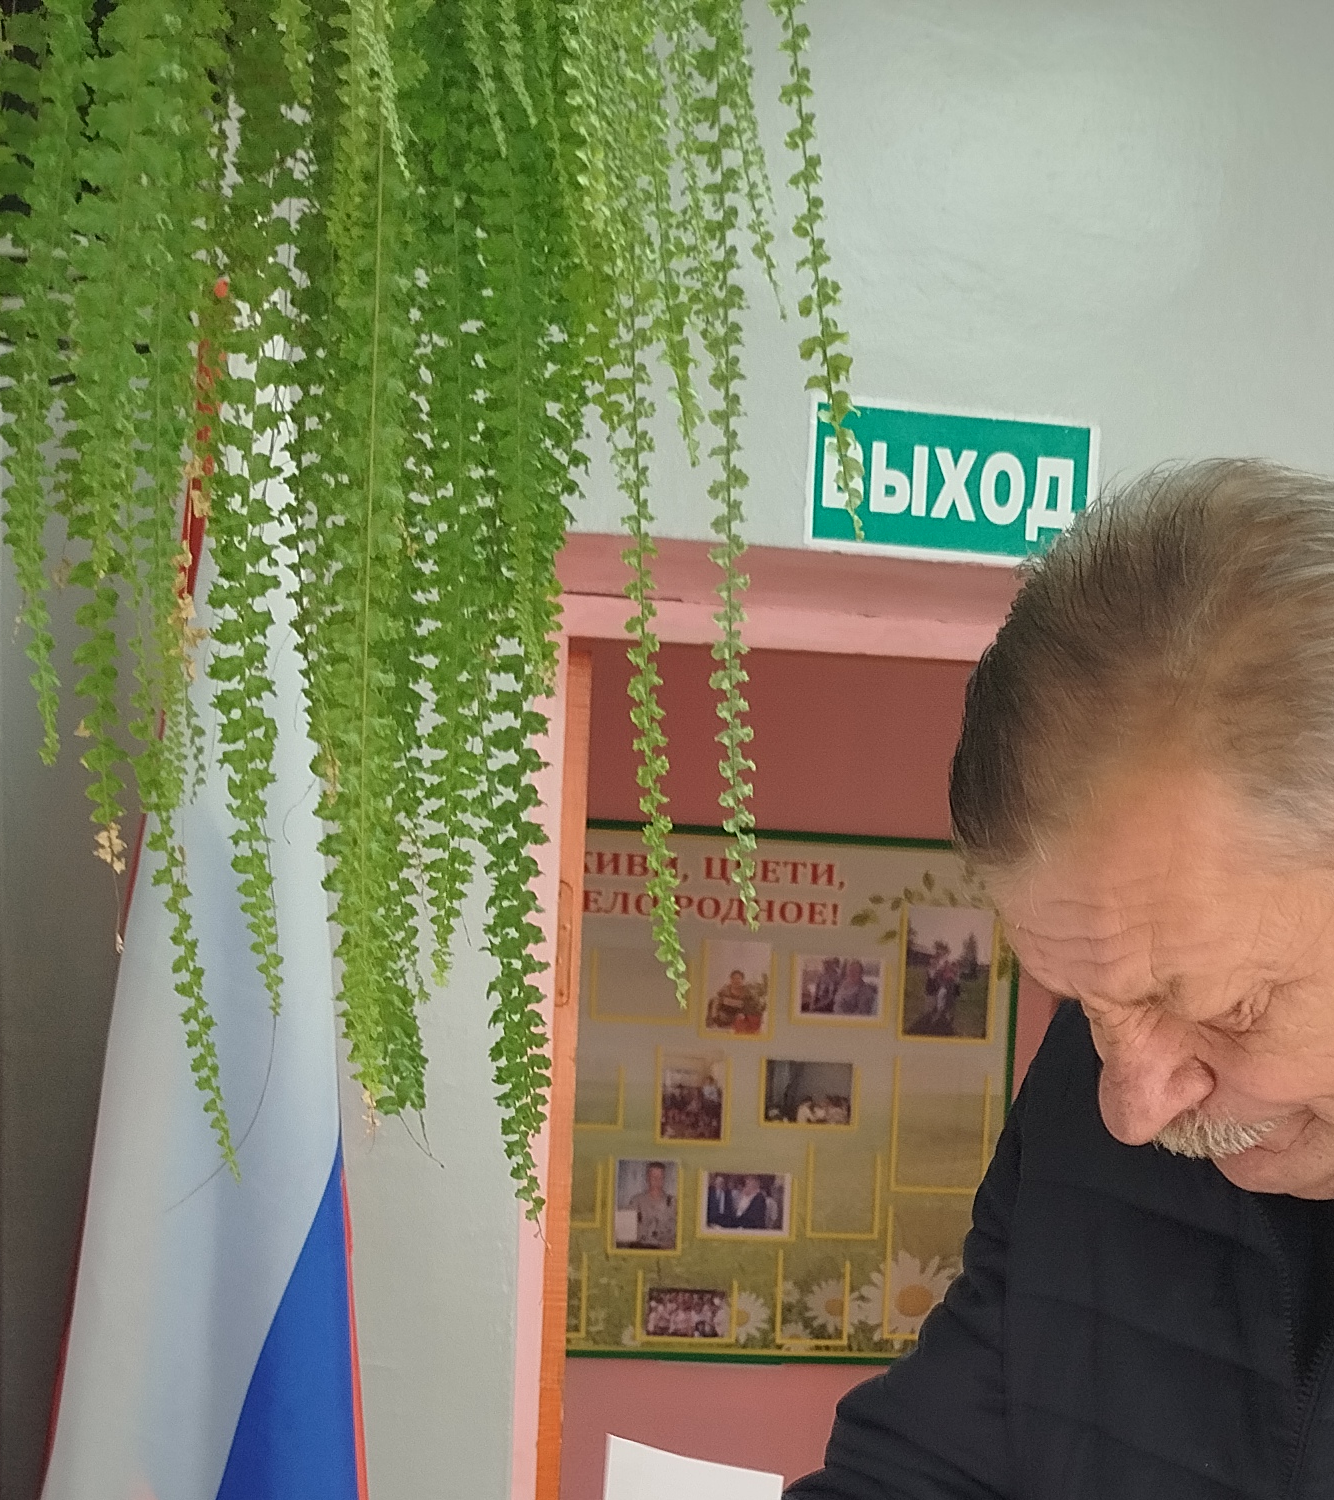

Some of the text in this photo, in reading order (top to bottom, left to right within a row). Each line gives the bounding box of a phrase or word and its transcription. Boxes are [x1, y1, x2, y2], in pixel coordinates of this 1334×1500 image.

[821, 435, 1076, 542] ВЫХОД
[705, 855, 845, 891] ЦЕТИ,
[583, 889, 660, 916] ЕЛО
